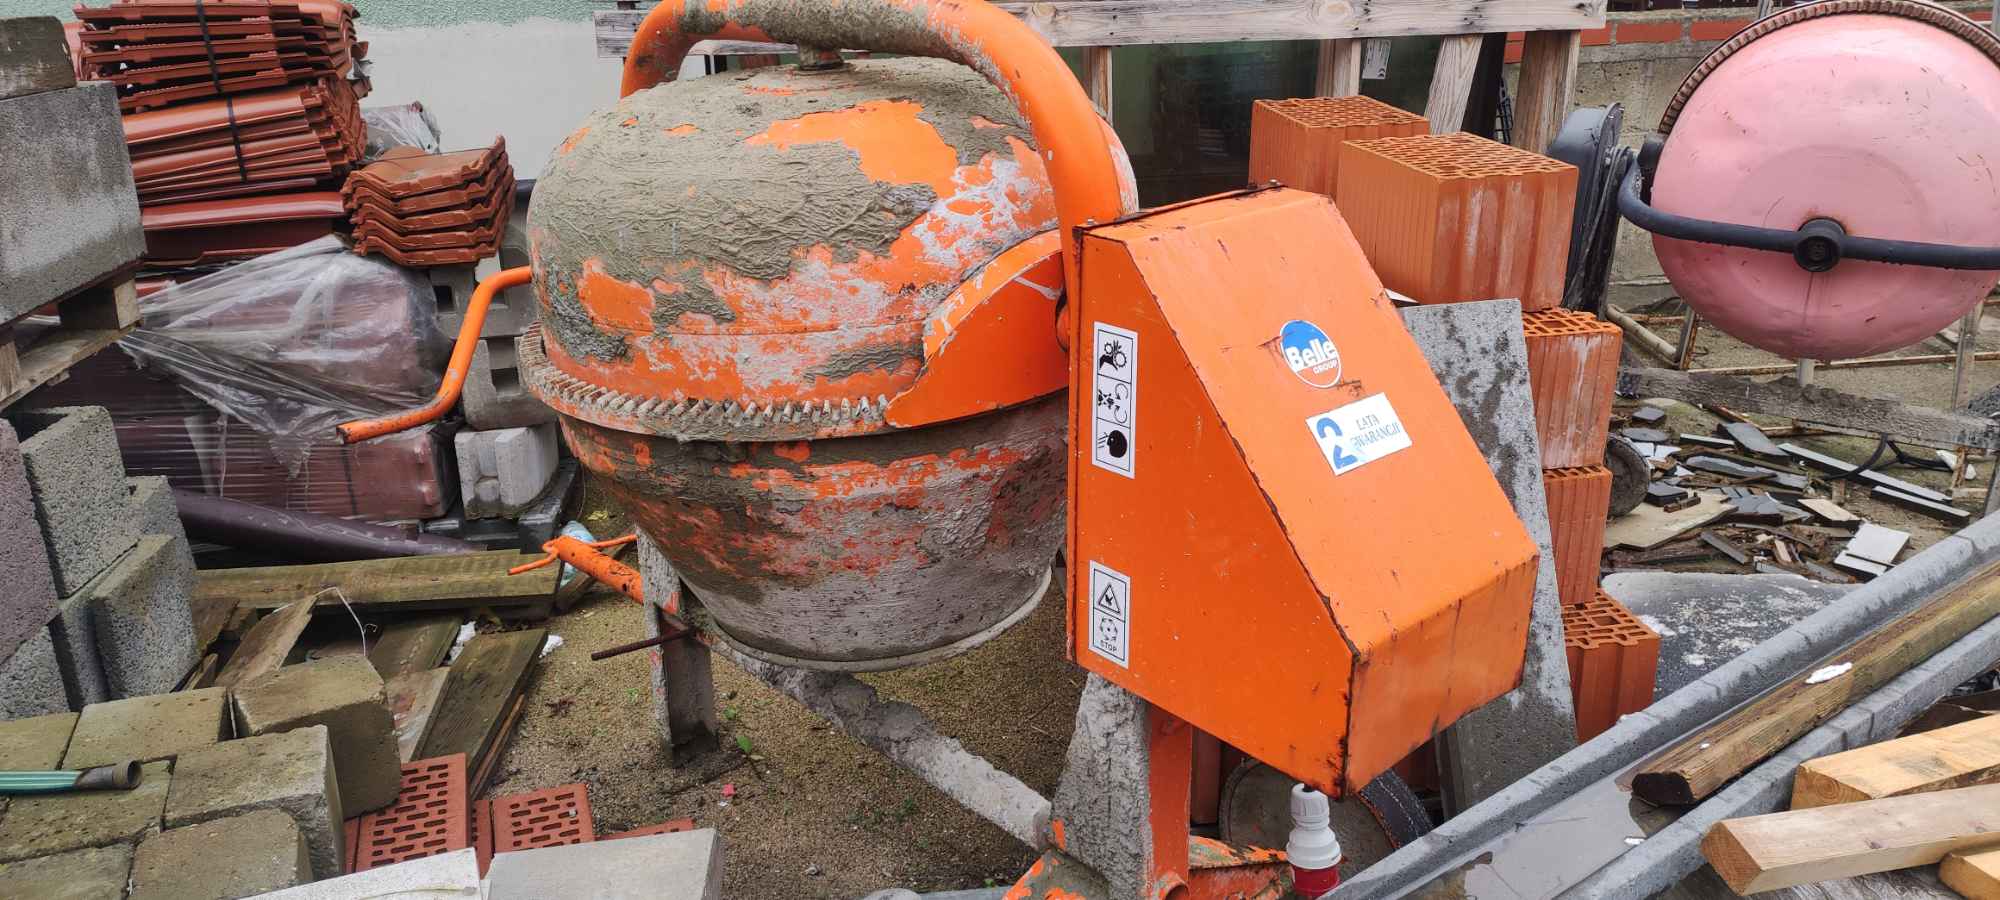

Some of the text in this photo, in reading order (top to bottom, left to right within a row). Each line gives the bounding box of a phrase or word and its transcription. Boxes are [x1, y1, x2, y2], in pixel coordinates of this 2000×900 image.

[1285, 338, 1337, 372] Belle
[1313, 360, 1338, 374] GROUP
[1356, 414, 1380, 430] LATA
[1317, 417, 1358, 469] 2
[1101, 640, 1117, 652] STOP
